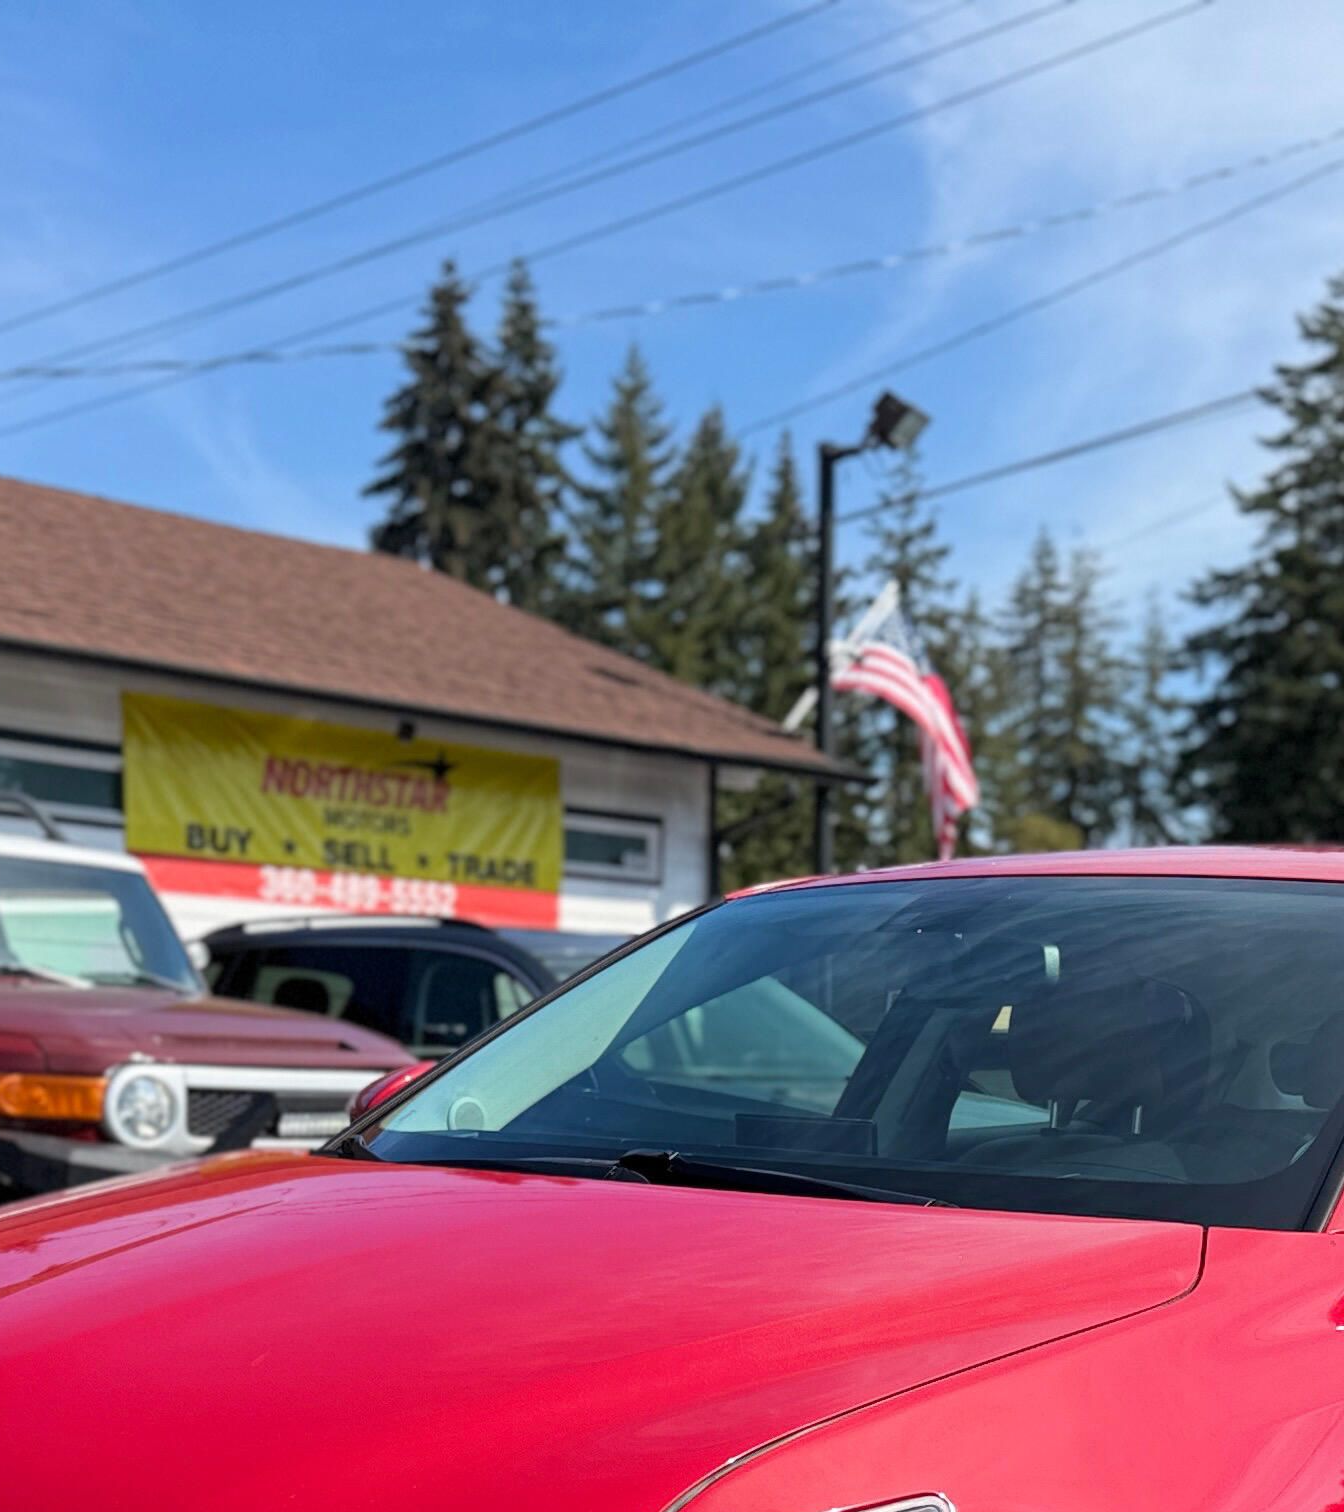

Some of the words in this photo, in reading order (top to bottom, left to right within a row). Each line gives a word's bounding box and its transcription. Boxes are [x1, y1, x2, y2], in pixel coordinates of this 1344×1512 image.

[261, 754, 453, 814] NORTHSTAR
[323, 808, 411, 836] MOTORS
[187, 823, 253, 855] BUY
[322, 841, 395, 872] SELL
[447, 852, 536, 885] TRADE
